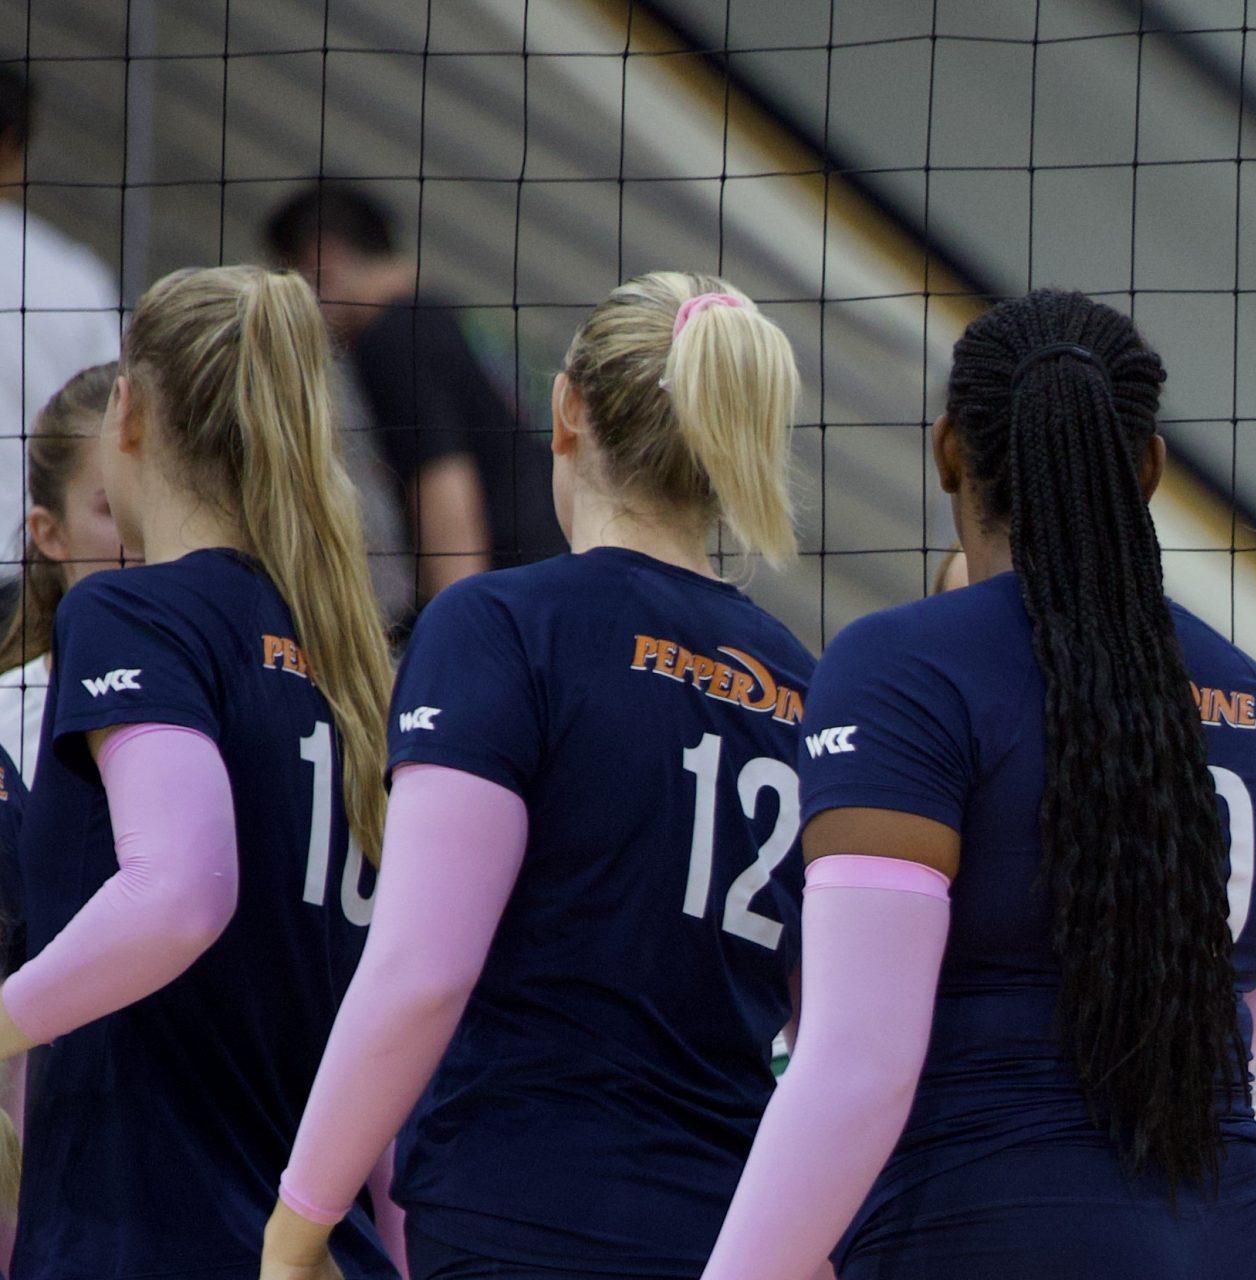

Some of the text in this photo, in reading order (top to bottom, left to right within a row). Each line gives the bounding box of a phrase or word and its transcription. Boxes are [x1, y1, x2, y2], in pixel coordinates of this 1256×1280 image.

[82, 669, 142, 697] WCC
[399, 706, 443, 733] WCC
[805, 725, 858, 759] WCC
[682, 732, 801, 950] 12
